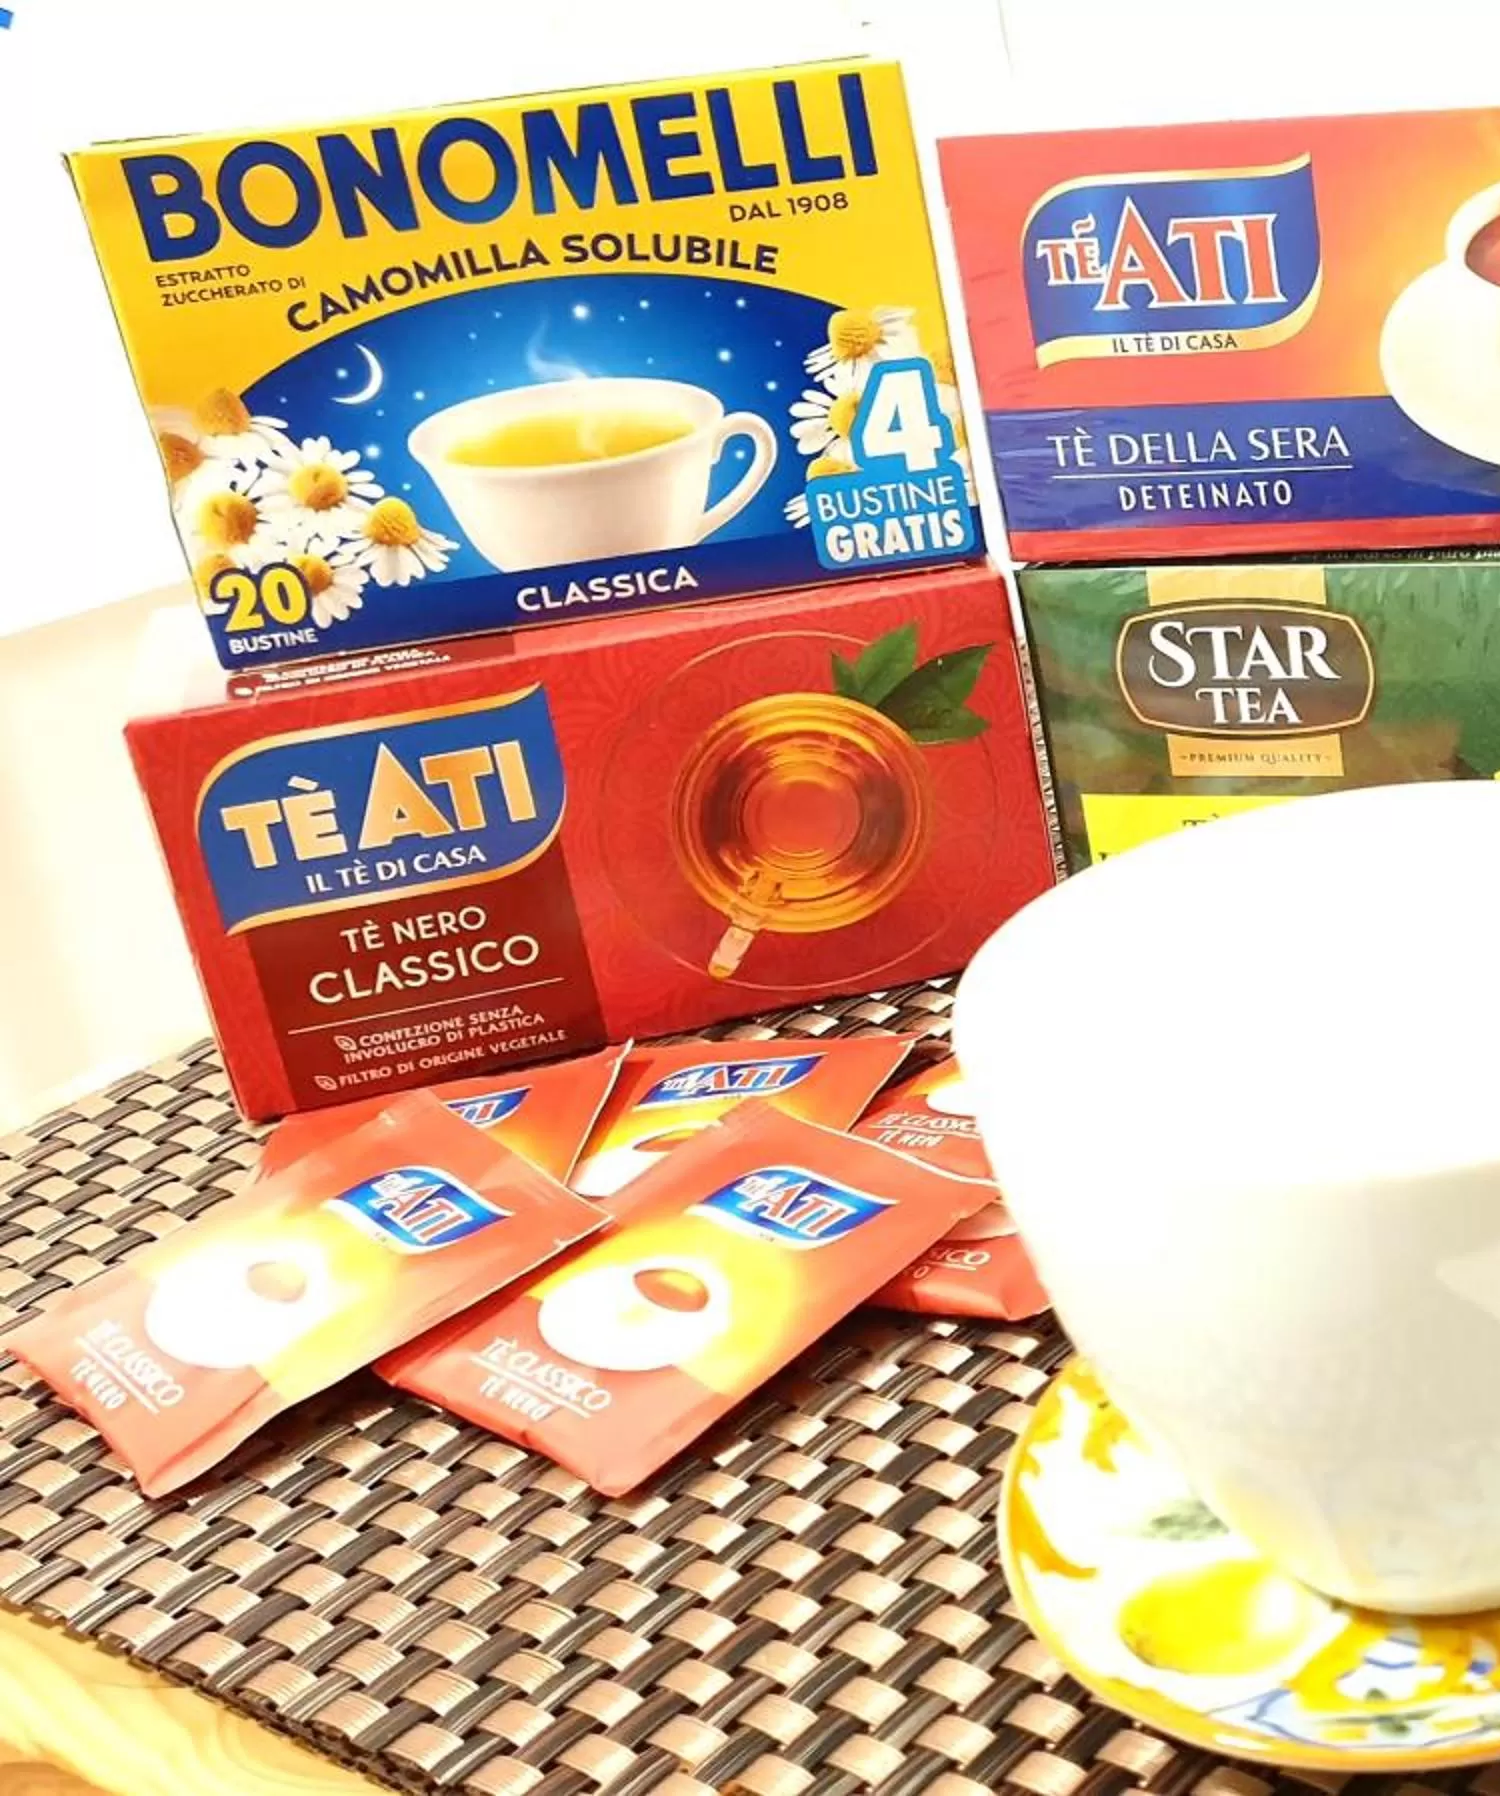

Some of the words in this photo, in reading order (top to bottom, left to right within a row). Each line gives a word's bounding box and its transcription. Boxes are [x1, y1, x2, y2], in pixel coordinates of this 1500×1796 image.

[123, 72, 879, 263] BONOMELLI
[729, 201, 781, 222] DAL
[788, 192, 848, 215] 1908
[156, 264, 251, 288] ESTRATTO
[1093, 195, 1287, 311] ATI
[161, 278, 282, 307] ZUCCHERATO
[288, 277, 305, 290] DI
[286, 240, 550, 332] CAMOMILLA
[562, 233, 778, 274] SOLUBILE
[1112, 338, 1128, 353] IL
[1134, 332, 1155, 352] TÈ
[1161, 336, 1180, 350] DI
[1186, 334, 1238, 350] CASA
[862, 369, 943, 472] 4
[1046, 427, 1096, 467] TÈ
[1109, 431, 1237, 465] DELLA
[1248, 426, 1349, 460] SERA
[816, 476, 957, 522] BUSTINE
[1120, 480, 1292, 510] DETEINATO
[826, 509, 965, 563] GRATIS
[217, 572, 307, 633] 20
[517, 565, 698, 612] CLASSICA
[229, 628, 318, 655] BUSTINE
[1148, 621, 1341, 688] STAR
[1196, 688, 1302, 724] TEA
[1189, 753, 1254, 763] PREMIUM
[1261, 753, 1322, 765] QUALITY
[221, 775, 348, 869] TÈ
[357, 740, 537, 850] ATI
[305, 874, 332, 894] IL
[336, 859, 372, 888] TÈ
[376, 858, 407, 881] DI
[413, 847, 487, 875] CASA
[340, 920, 384, 953] TÈ
[394, 906, 487, 944] NERO
[309, 935, 540, 1004] CLASSICO
[344, 1034, 441, 1064] INVOLUCRO
[446, 1028, 464, 1043] DI
[469, 1013, 545, 1039] PLASTICA
[359, 1015, 464, 1048] CONFEZIONE
[469, 1004, 524, 1024] SENZA
[339, 1066, 392, 1087] FILTRO
[397, 1058, 415, 1073] DI
[420, 1047, 485, 1069] ORIGINE
[490, 1030, 567, 1054] VEGETALE
[368, 1183, 474, 1244] ATI
[736, 1181, 858, 1237] ATI
